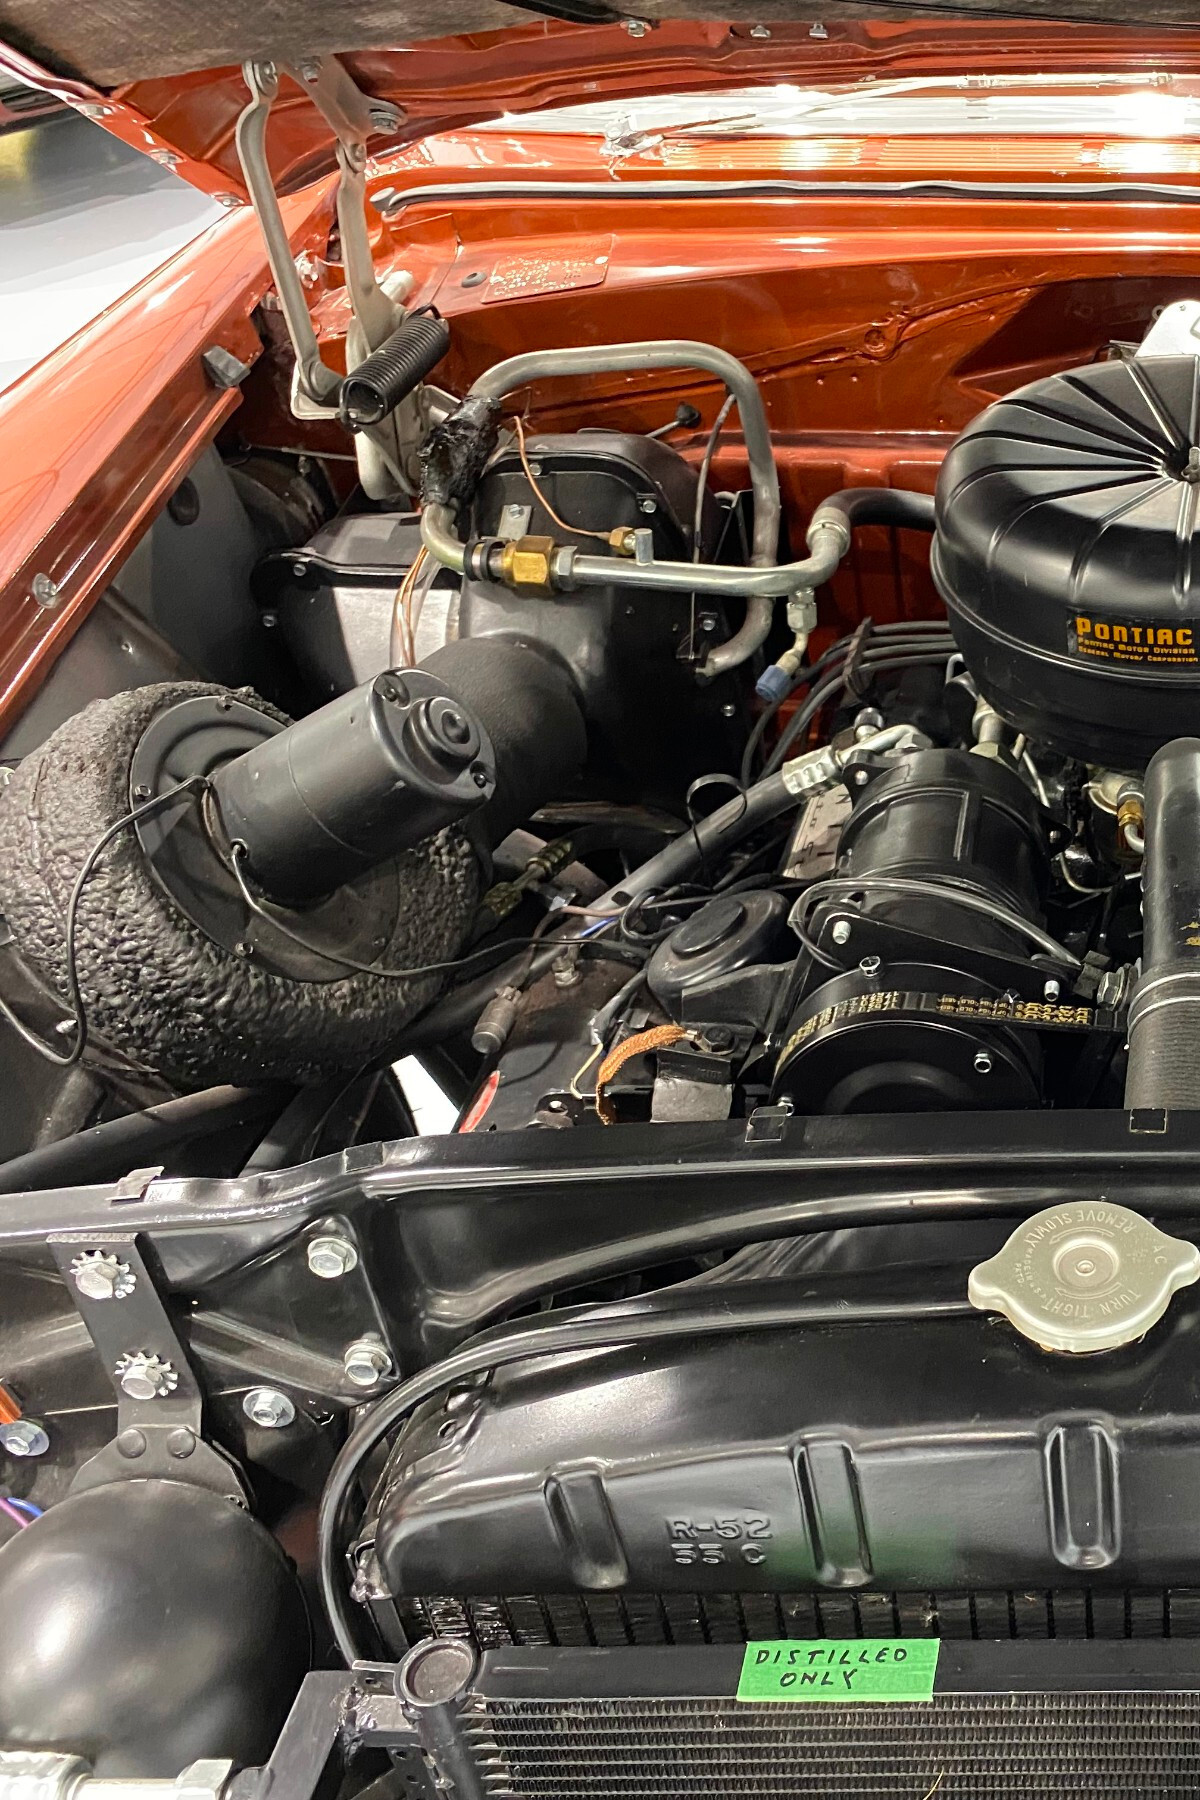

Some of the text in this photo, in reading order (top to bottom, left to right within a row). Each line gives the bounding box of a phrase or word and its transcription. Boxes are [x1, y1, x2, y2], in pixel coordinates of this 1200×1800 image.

[1024, 1210, 1137, 1246] REMOVE SLOWLY
[1041, 1289, 1142, 1318] TURN TIGHT
[665, 1518, 773, 1540] R-52
[741, 1543, 766, 1564] C
[755, 1647, 908, 1664] DISTILLED
[779, 1668, 858, 1689] ONLY
